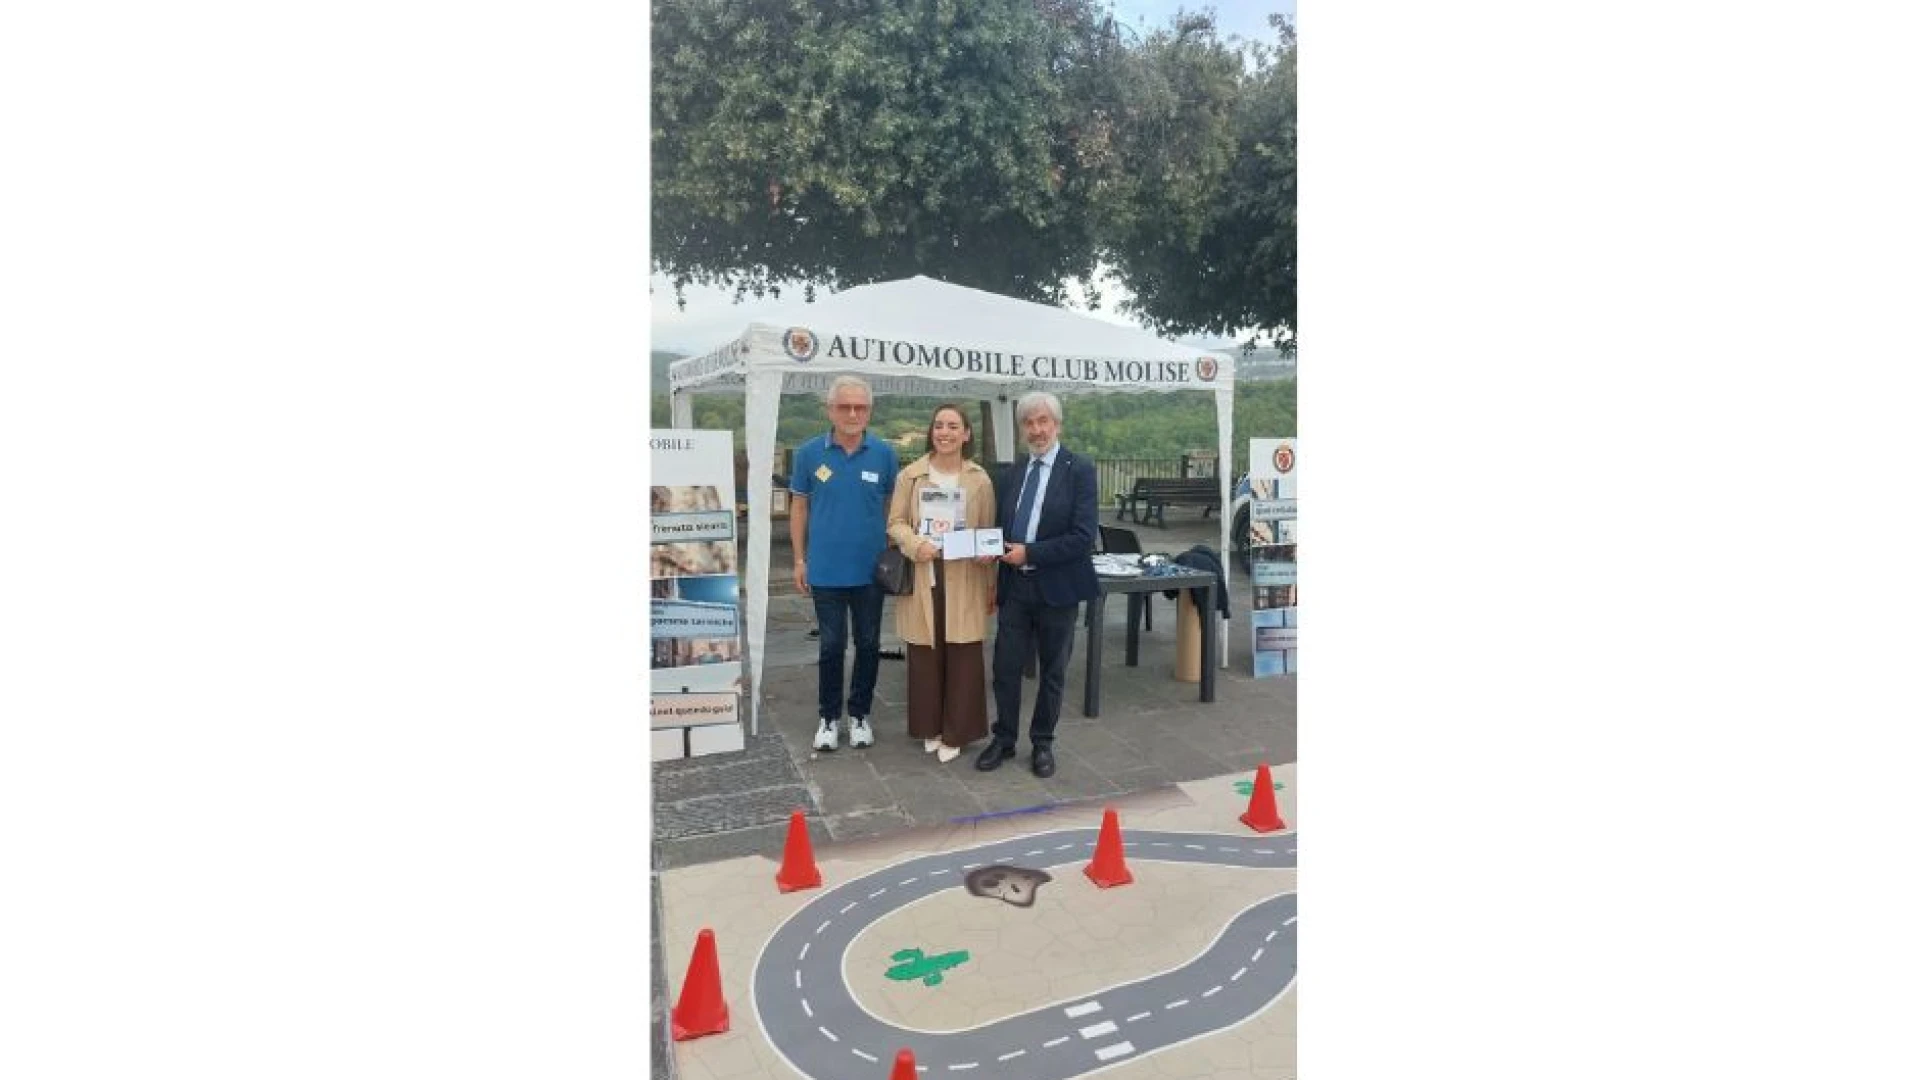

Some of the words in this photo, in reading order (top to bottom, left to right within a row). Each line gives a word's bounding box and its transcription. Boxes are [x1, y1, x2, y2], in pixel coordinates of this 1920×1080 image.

[827, 335, 1026, 377] AUTOMOBILE
[1031, 356, 1098, 381] CLUB
[1104, 360, 1191, 382] MOLISE
